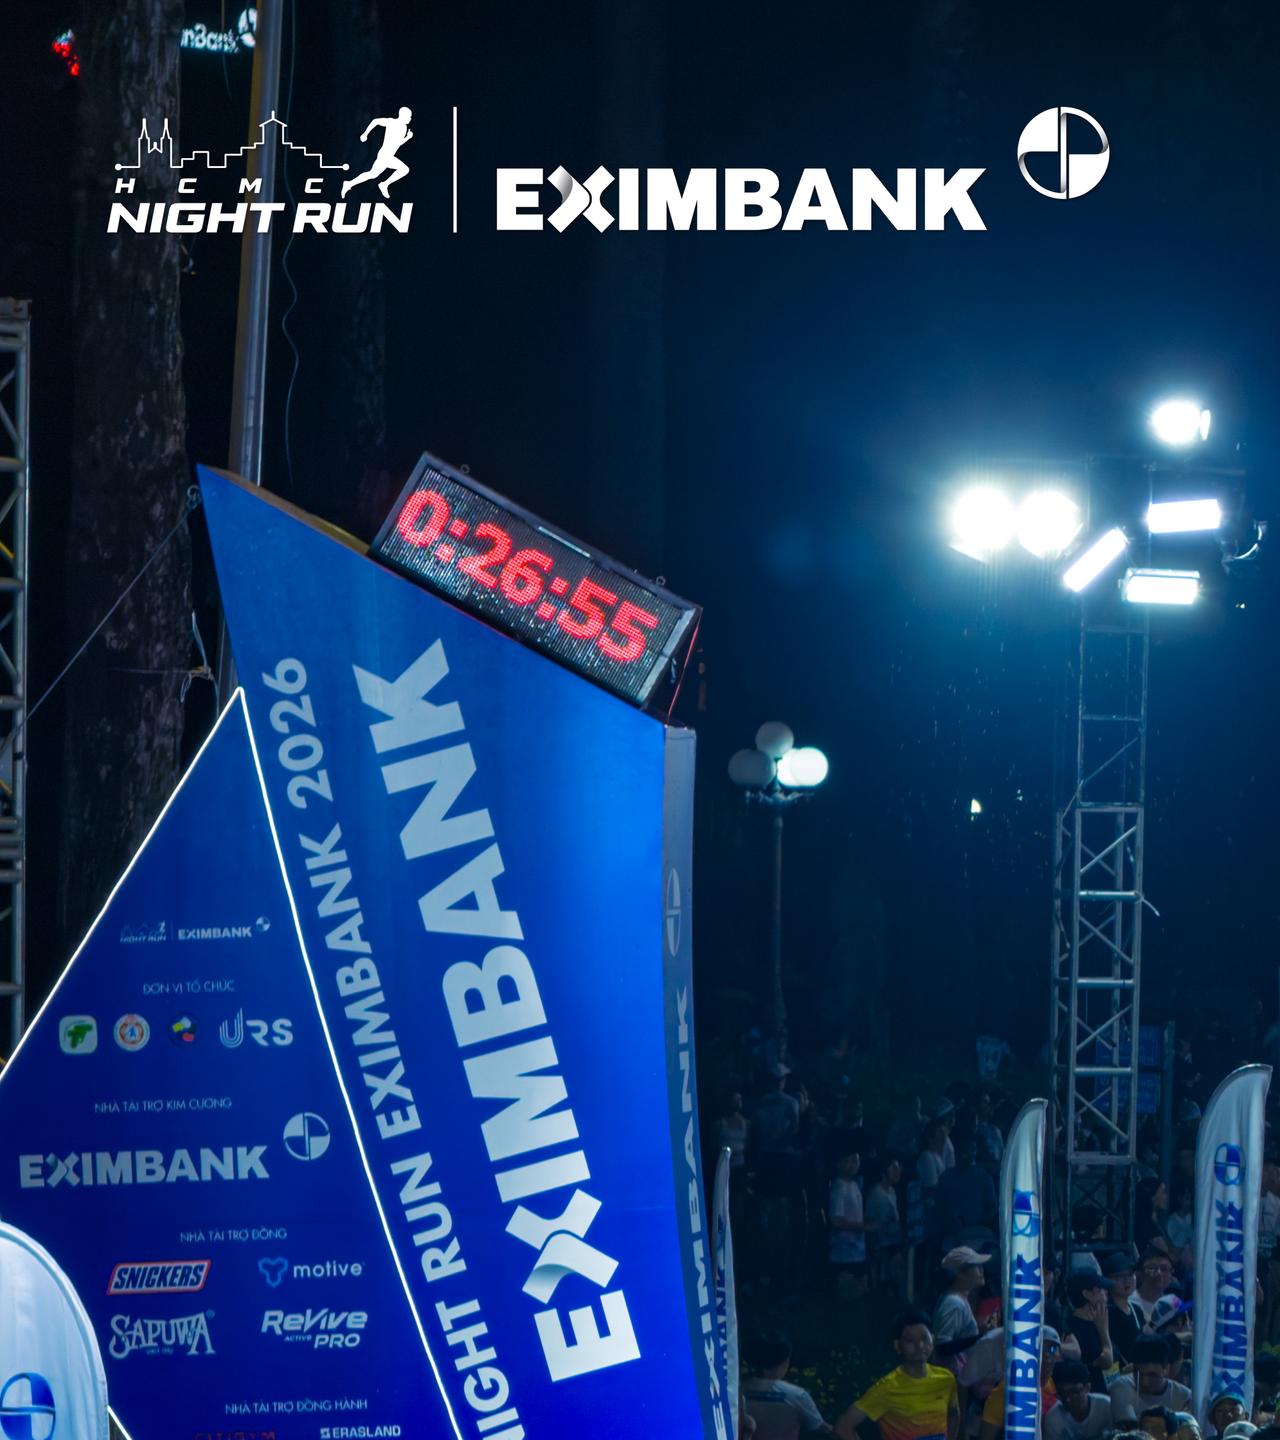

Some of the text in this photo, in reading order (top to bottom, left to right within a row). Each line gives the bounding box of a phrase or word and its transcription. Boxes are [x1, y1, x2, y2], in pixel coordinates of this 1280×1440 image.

[397, 489, 660, 662] 0:26:55
[261, 656, 335, 811] 2026
[178, 926, 253, 941] EXIMBANK
[299, 822, 422, 1140] EXIMBANK
[352, 637, 641, 1382] EXIMBANK
[19, 1145, 270, 1188] EXIMBANK
[390, 1151, 467, 1283] RUN
[113, 1261, 363, 1290] SNICKERS motive
[314, 1333, 361, 1349] PRO
[1211, 1199, 1245, 1398] XIMBANK
